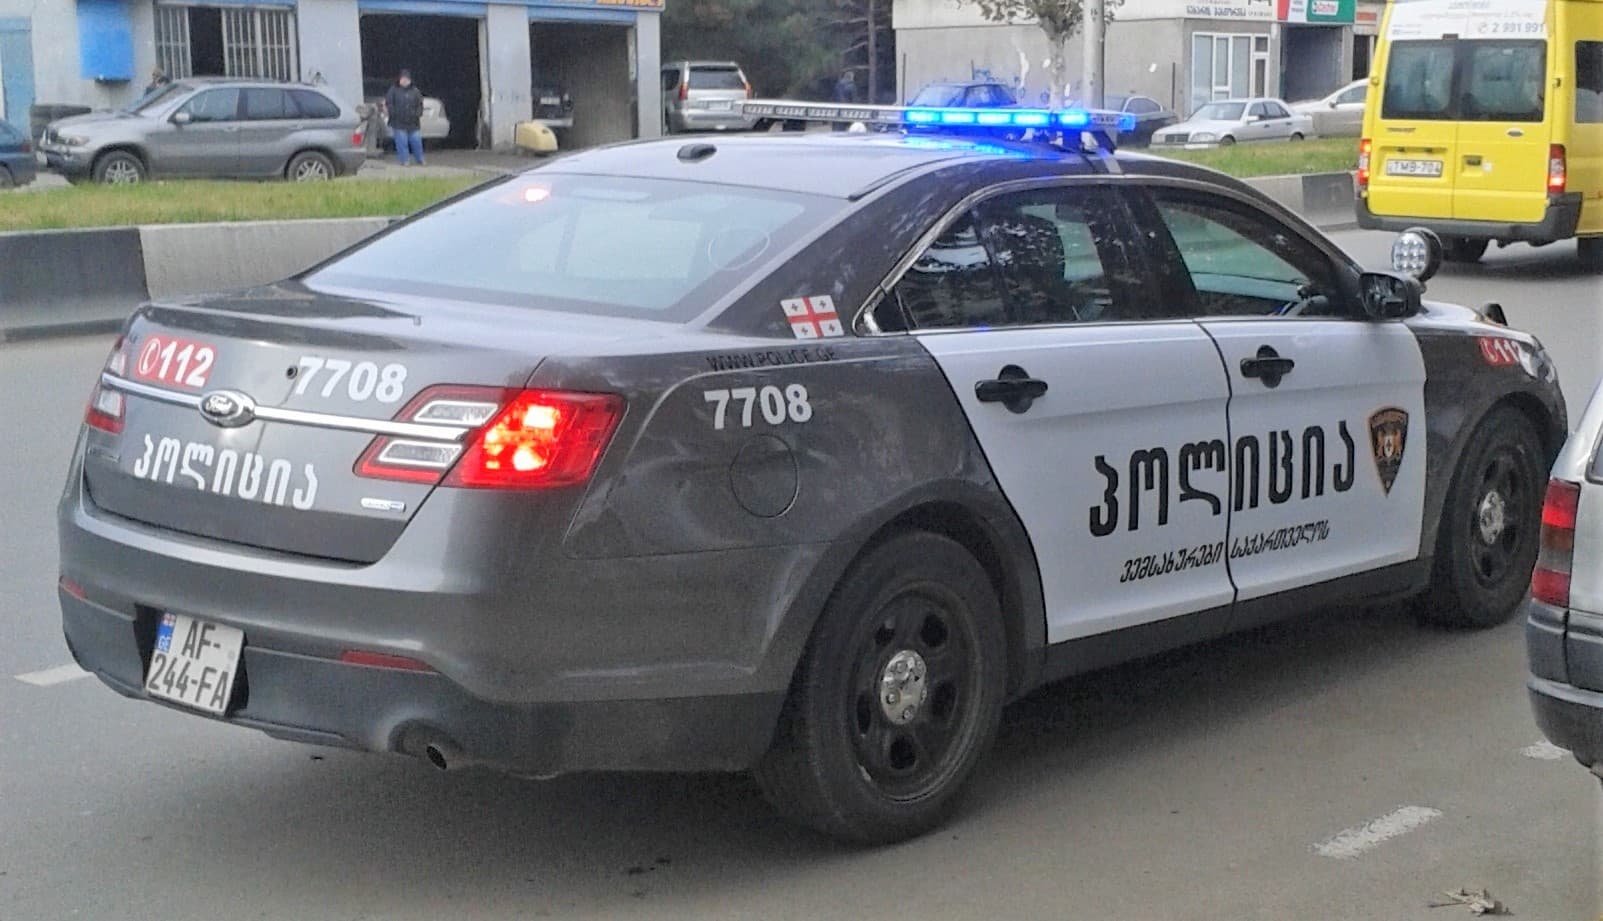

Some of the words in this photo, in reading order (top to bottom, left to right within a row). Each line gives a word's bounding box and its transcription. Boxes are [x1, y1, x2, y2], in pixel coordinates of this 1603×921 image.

[158, 340, 215, 388] 112
[295, 356, 408, 403] 7708
[703, 383, 813, 430] 7708
[134, 433, 318, 510] პოლიცია
[1089, 420, 1355, 537] პოლიცია
[148, 653, 229, 710] 244-FA
